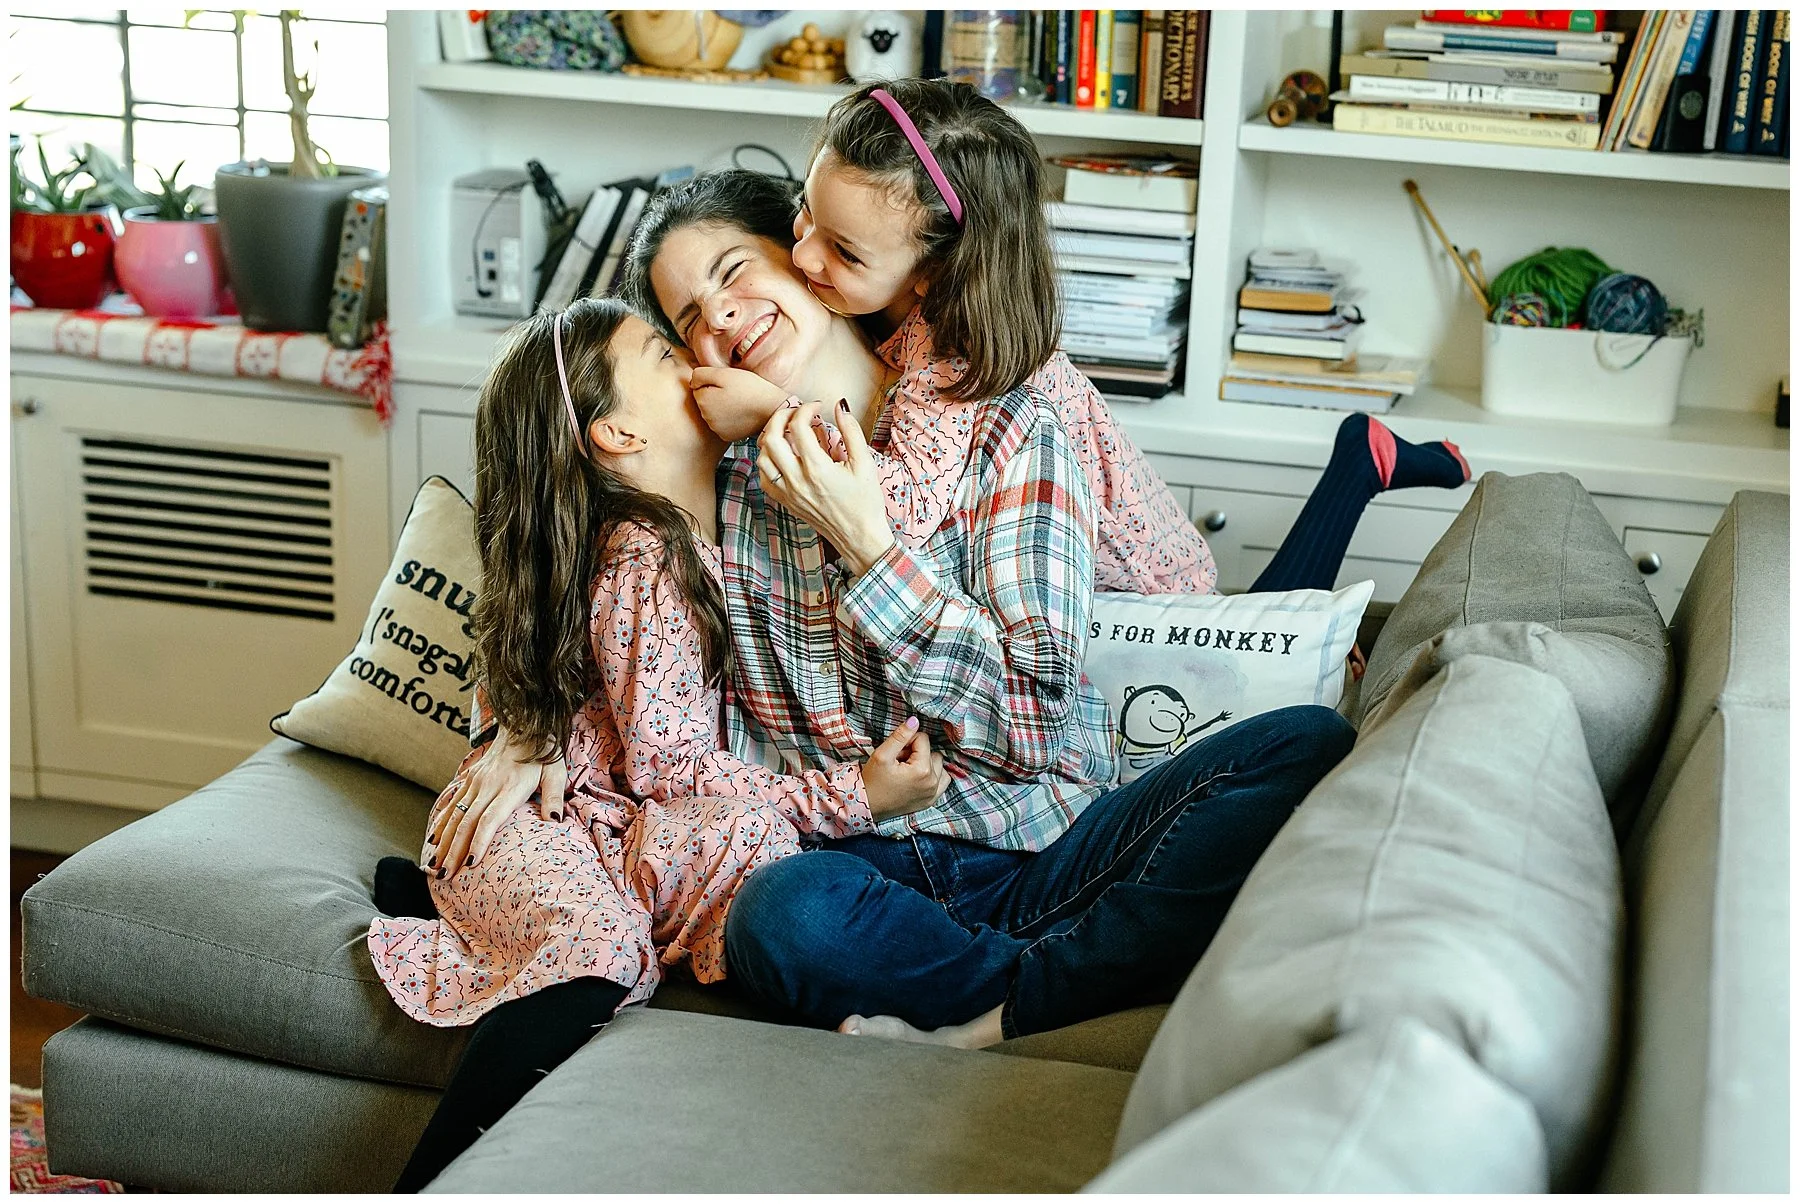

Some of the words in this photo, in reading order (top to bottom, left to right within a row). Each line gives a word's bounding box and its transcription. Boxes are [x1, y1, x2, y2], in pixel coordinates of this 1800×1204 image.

[1741, 35, 1757, 72] BOOK
[1767, 42, 1782, 78] BOOK
[1739, 72, 1751, 89] OF
[1765, 79, 1777, 95] OF
[1735, 90, 1749, 118] WHY
[1089, 621, 1102, 639] S
[1109, 624, 1155, 644] FOR
[1164, 625, 1299, 656] MONKEY
